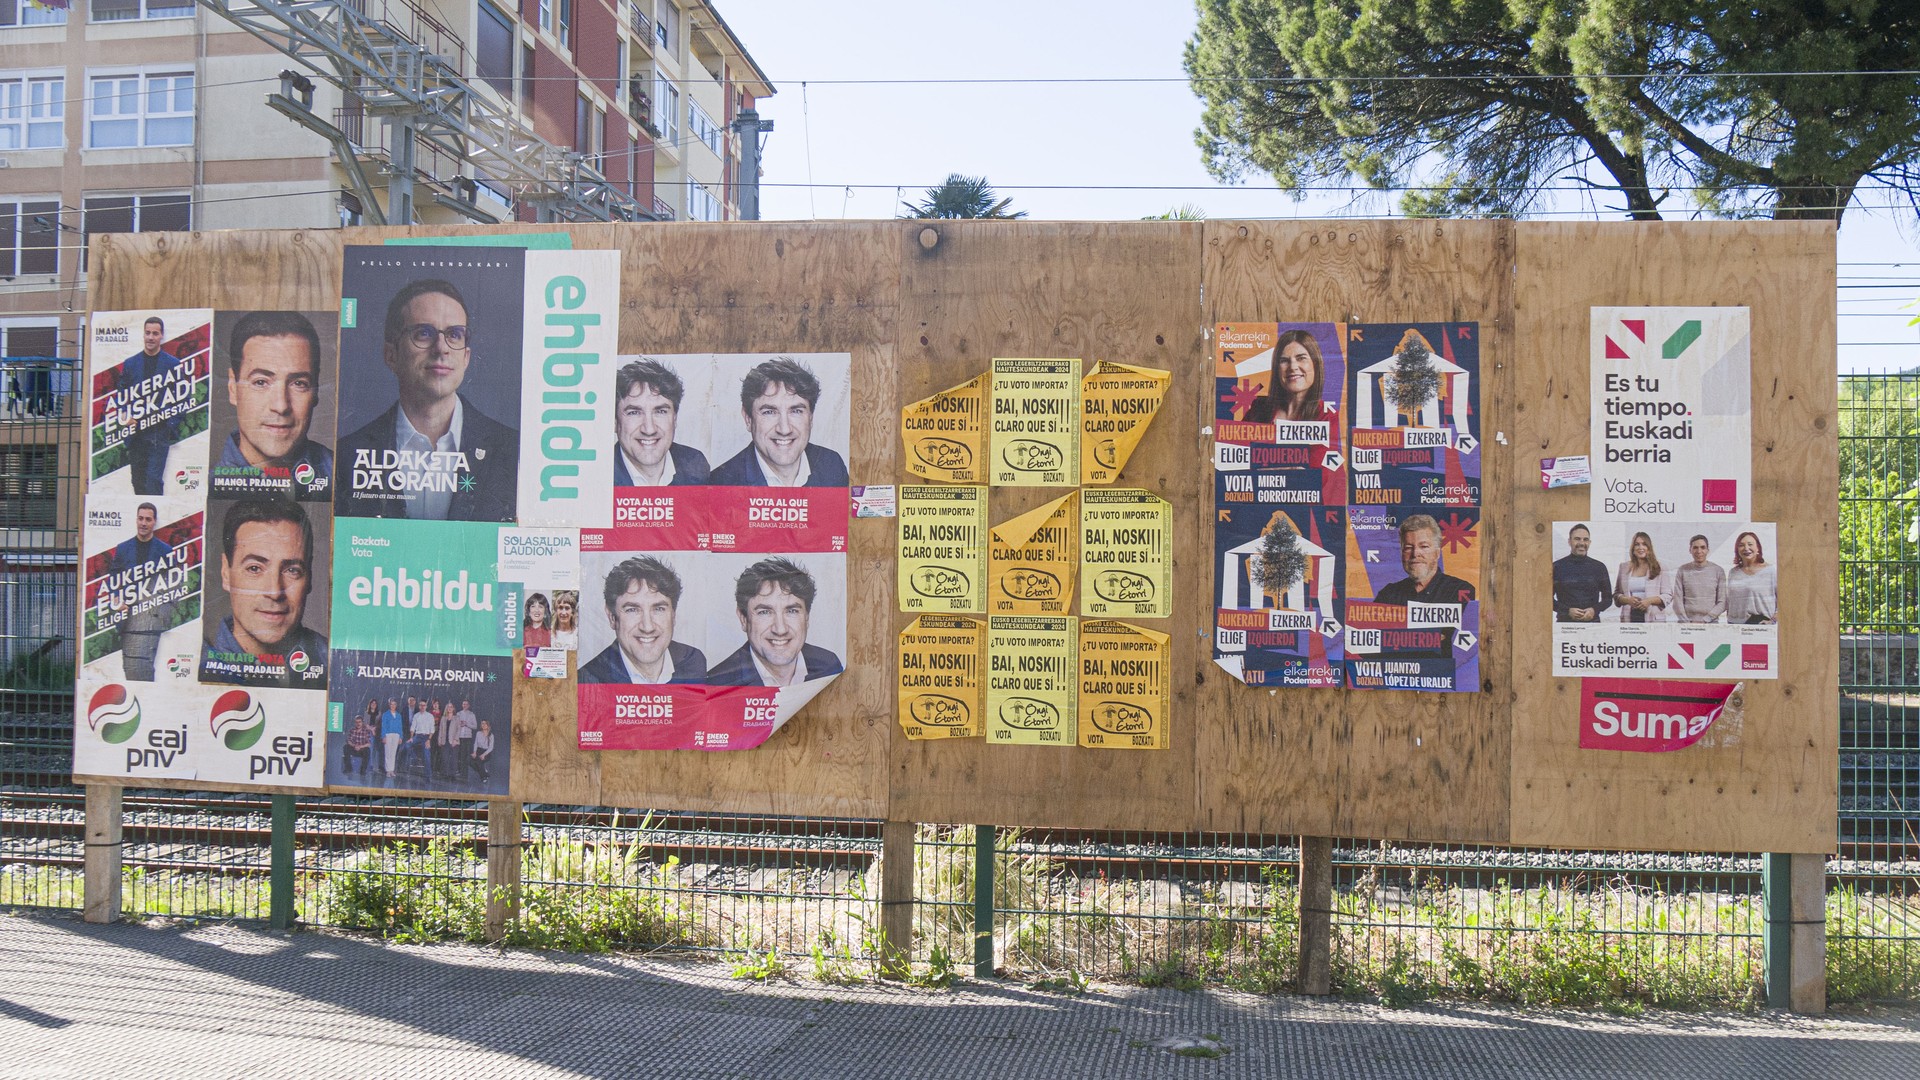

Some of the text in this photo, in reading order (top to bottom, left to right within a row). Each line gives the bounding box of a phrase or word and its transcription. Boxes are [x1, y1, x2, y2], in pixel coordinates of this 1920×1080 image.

[96, 328, 128, 336] IMANOL
[1219, 332, 1270, 342] elkarrekin
[105, 358, 196, 412] AUKERATU
[540, 275, 601, 502] ehbildu
[994, 381, 1068, 390] ¿TU VOTO IMPORTA?
[1084, 380, 1158, 392] ¿TU VOTO IMPORTA?
[1604, 373, 1660, 393] Es tu
[105, 375, 196, 433] EUSKADI
[996, 398, 1018, 418] BAI,
[1604, 396, 1692, 421] tiempo.
[105, 397, 197, 446] ELIGE BIENESTAR
[906, 417, 966, 431] CLARO QUE SÍ
[994, 418, 1057, 432] CLARO QUE SÍ
[1218, 424, 1328, 441] AUKERATU EZKERRA
[1604, 420, 1693, 440] Euskadi
[1352, 432, 1448, 446] AUKERATU EZKERRA
[1028, 446, 1052, 459] Ongi
[1220, 448, 1310, 466] ELIGE IZQUIERDA
[1355, 450, 1432, 466] ELIGE IZQUIERDA
[1604, 444, 1672, 463] berria
[353, 448, 471, 472] ALDAKETA
[1027, 458, 1054, 469] Etorri
[214, 466, 291, 478] BOZKATU VOTA
[999, 472, 1064, 482] VOTA BOZKATU
[214, 478, 291, 488] IMANOL PRADALES
[352, 469, 458, 493] DA ORAIN
[1225, 474, 1286, 492] VOTA MIREN
[1354, 474, 1382, 488] VOTA
[1604, 478, 1648, 494] Vota.
[358, 492, 378, 500] futuro
[904, 492, 956, 500] HAUTESKUNDEAK
[1224, 490, 1320, 503] BOZKATU GORROTXATEGI
[1356, 488, 1402, 504] BOZKATU
[1420, 484, 1478, 496] elkarrekin
[616, 498, 674, 506] VOTA AL QUE
[749, 498, 808, 508] VOTA AL QUE
[1420, 496, 1460, 504] Podemos
[1604, 498, 1676, 514] Bozkatu
[1704, 502, 1735, 512] Sumar
[88, 511, 122, 519] IMANOL
[616, 506, 674, 521] DECIDE
[748, 508, 808, 522] DECIDE
[1084, 511, 1160, 522] ¿TU VOTO IMPORTA?
[1350, 514, 1397, 524] elkarrekin
[798, 522, 808, 530] DA
[351, 536, 390, 547] Bozkatu
[504, 536, 572, 547] SOLASALDIA
[351, 547, 373, 558] Vota
[504, 546, 553, 556] LAUDION
[992, 546, 1054, 562] CLARO QUE SÍ
[98, 546, 188, 596] AUKERATU
[98, 563, 188, 617] EUSKADI
[348, 566, 494, 612] ehbildu
[98, 586, 188, 630] ELIGE BIENESTAR
[1348, 606, 1460, 624] AUKERATU EZKERRA
[504, 592, 517, 640] ehbildu
[1218, 614, 1312, 628] AUKERATU EZKERRA
[1220, 631, 1296, 648] ELIGE IZQUIERDA
[1350, 630, 1441, 650] ELIGE IZQUIERDA
[1561, 642, 1650, 658] Es tu tiempo.
[206, 661, 286, 676] IMANOL PRADALES
[1354, 662, 1420, 678] VOTA JUANTXO
[1561, 656, 1658, 670] Euskadi berria
[1743, 660, 1768, 670] Sumar
[357, 666, 484, 683] ALDAKETA DA ORAIN
[1284, 666, 1340, 676] elkarrekin
[1083, 680, 1146, 694] CLARO QUE SÍ
[1284, 676, 1322, 684] Podemos
[1356, 674, 1452, 689] BOZKATU LÓPEZ DE URALDE
[616, 695, 672, 704] VOTA AL QUE
[745, 698, 770, 706] VOTA
[616, 704, 673, 718] DECIDE
[1592, 700, 1723, 740] Sumar
[148, 724, 188, 755] eaj
[272, 731, 314, 762] eaj
[126, 748, 176, 772] pnv
[250, 754, 301, 780] pnv
